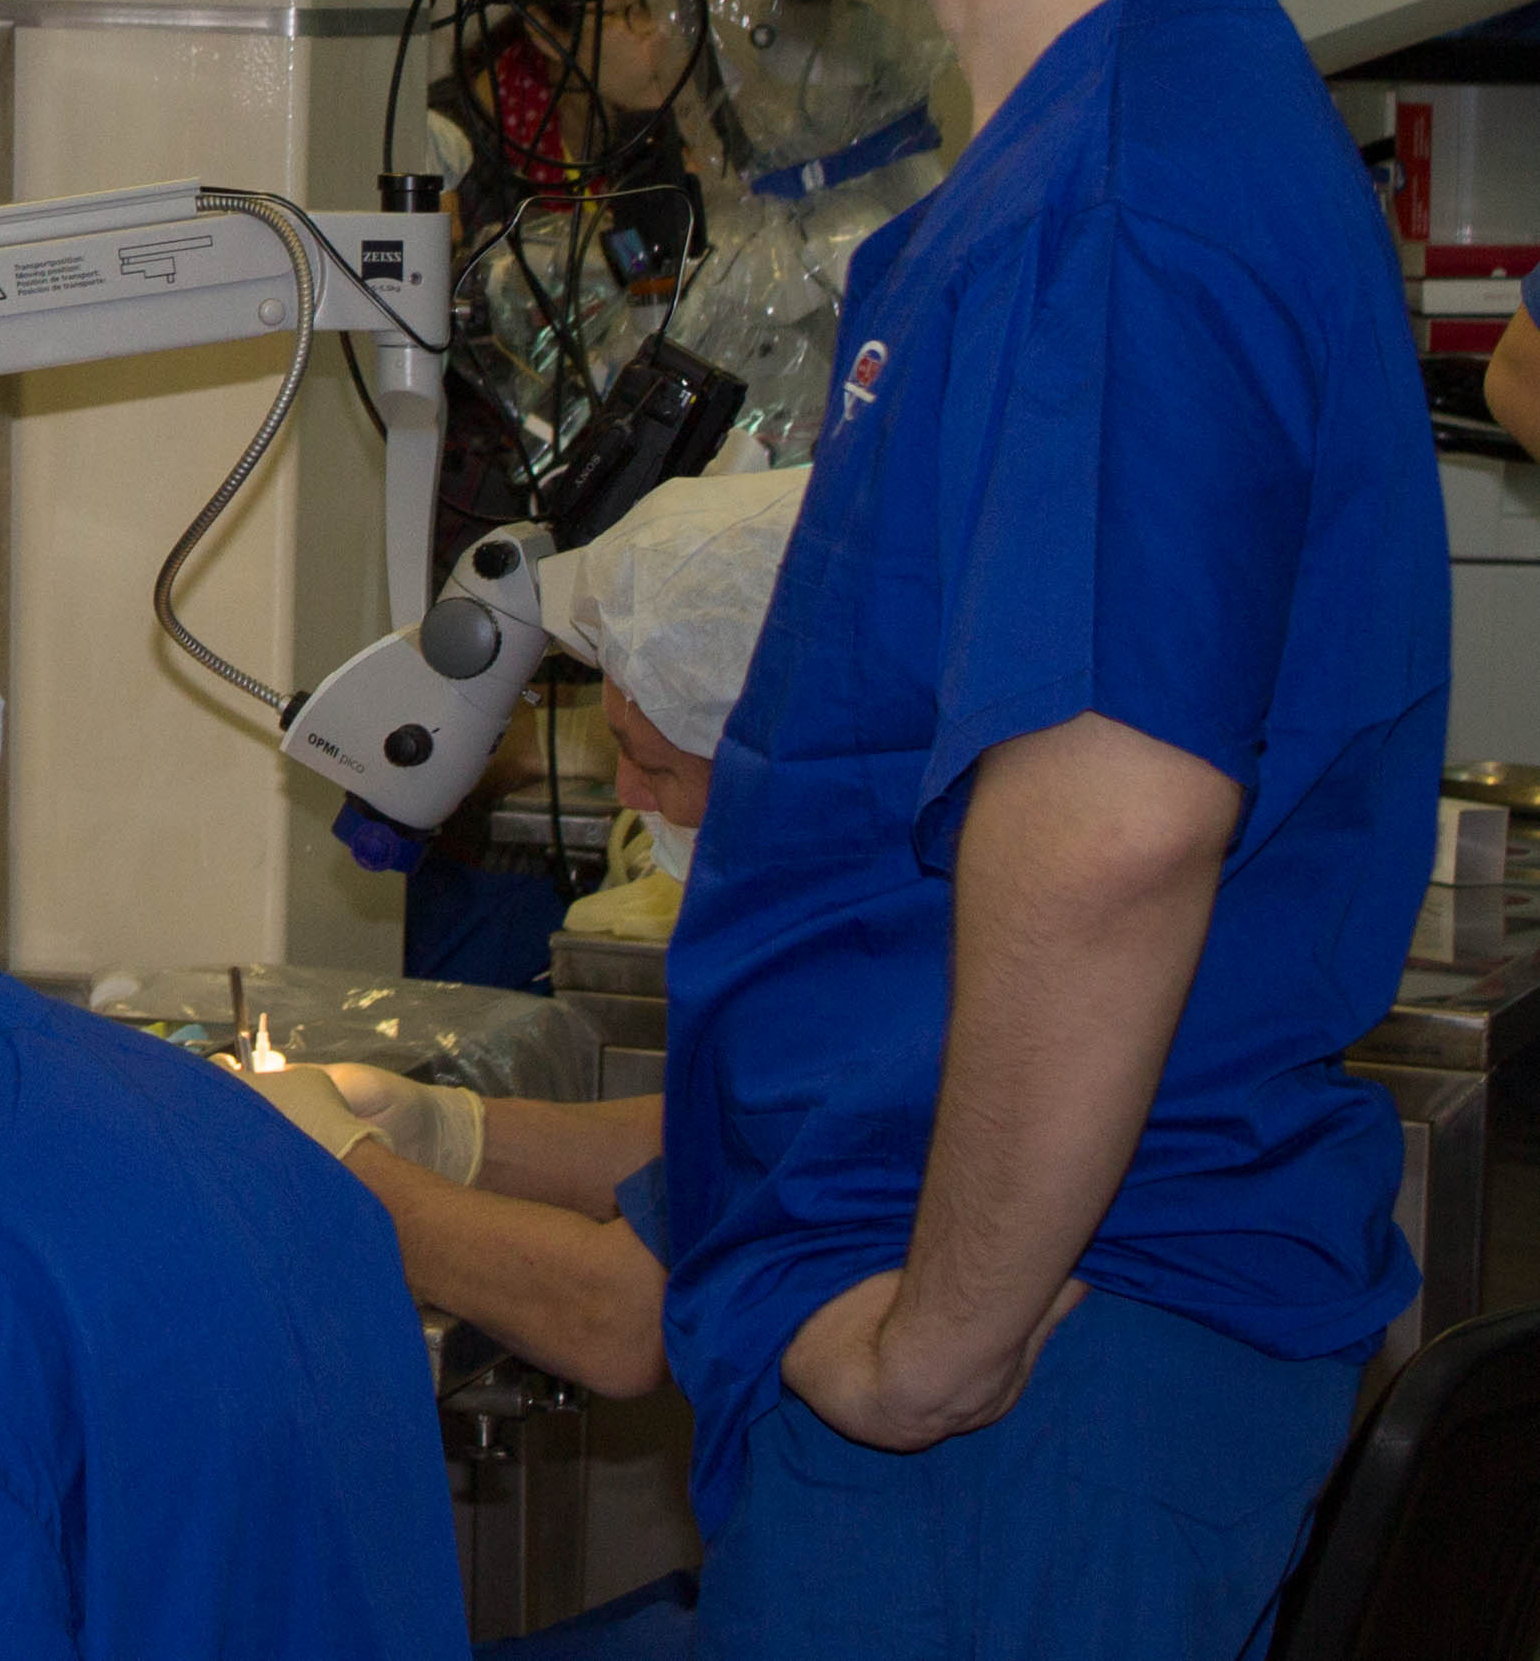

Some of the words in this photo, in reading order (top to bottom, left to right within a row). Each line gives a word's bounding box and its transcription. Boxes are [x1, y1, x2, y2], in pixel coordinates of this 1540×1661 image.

[363, 251, 402, 263] ZEISS
[307, 732, 340, 759] OPMI
[338, 753, 365, 774] pico
